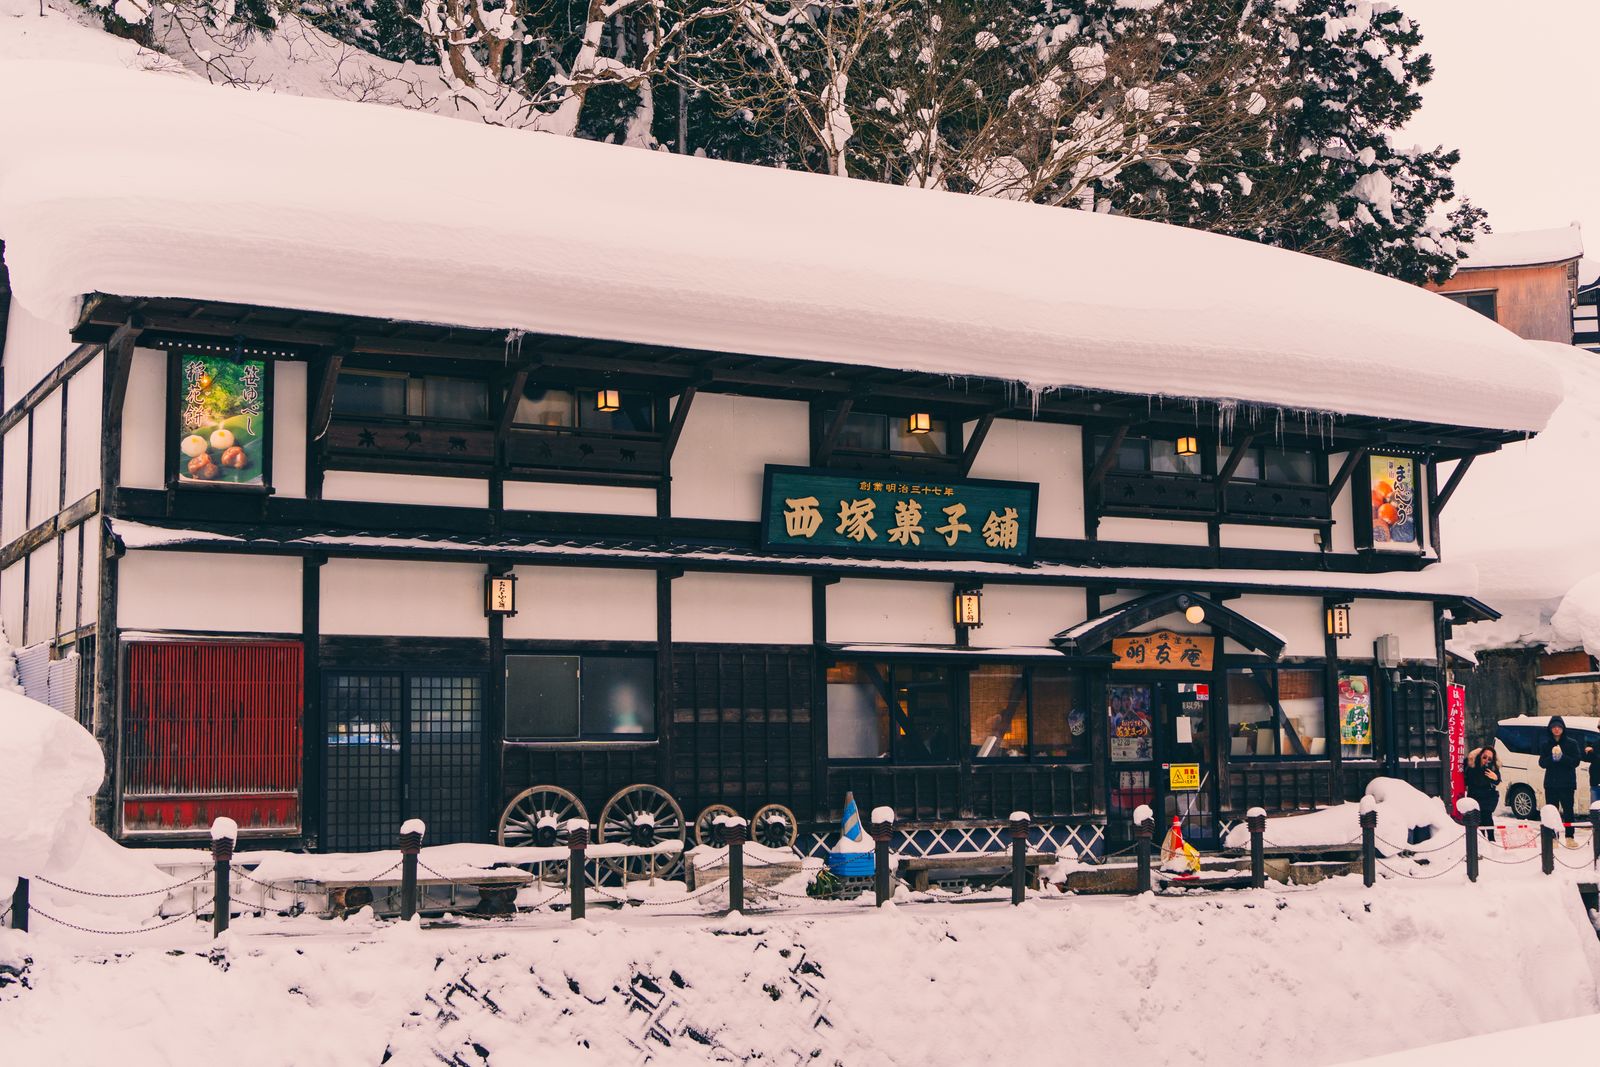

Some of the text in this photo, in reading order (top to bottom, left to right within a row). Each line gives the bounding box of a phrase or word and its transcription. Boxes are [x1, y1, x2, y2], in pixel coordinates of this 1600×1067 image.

[184, 360, 206, 426] 稲花餅
[240, 364, 260, 436] 笹ゆべし
[858, 481, 955, 497] 創業明治三十七年
[1393, 464, 1413, 526] まんじゅう
[783, 496, 1020, 549] 西塚菓子舗
[1126, 641, 1203, 667] 明友庵
